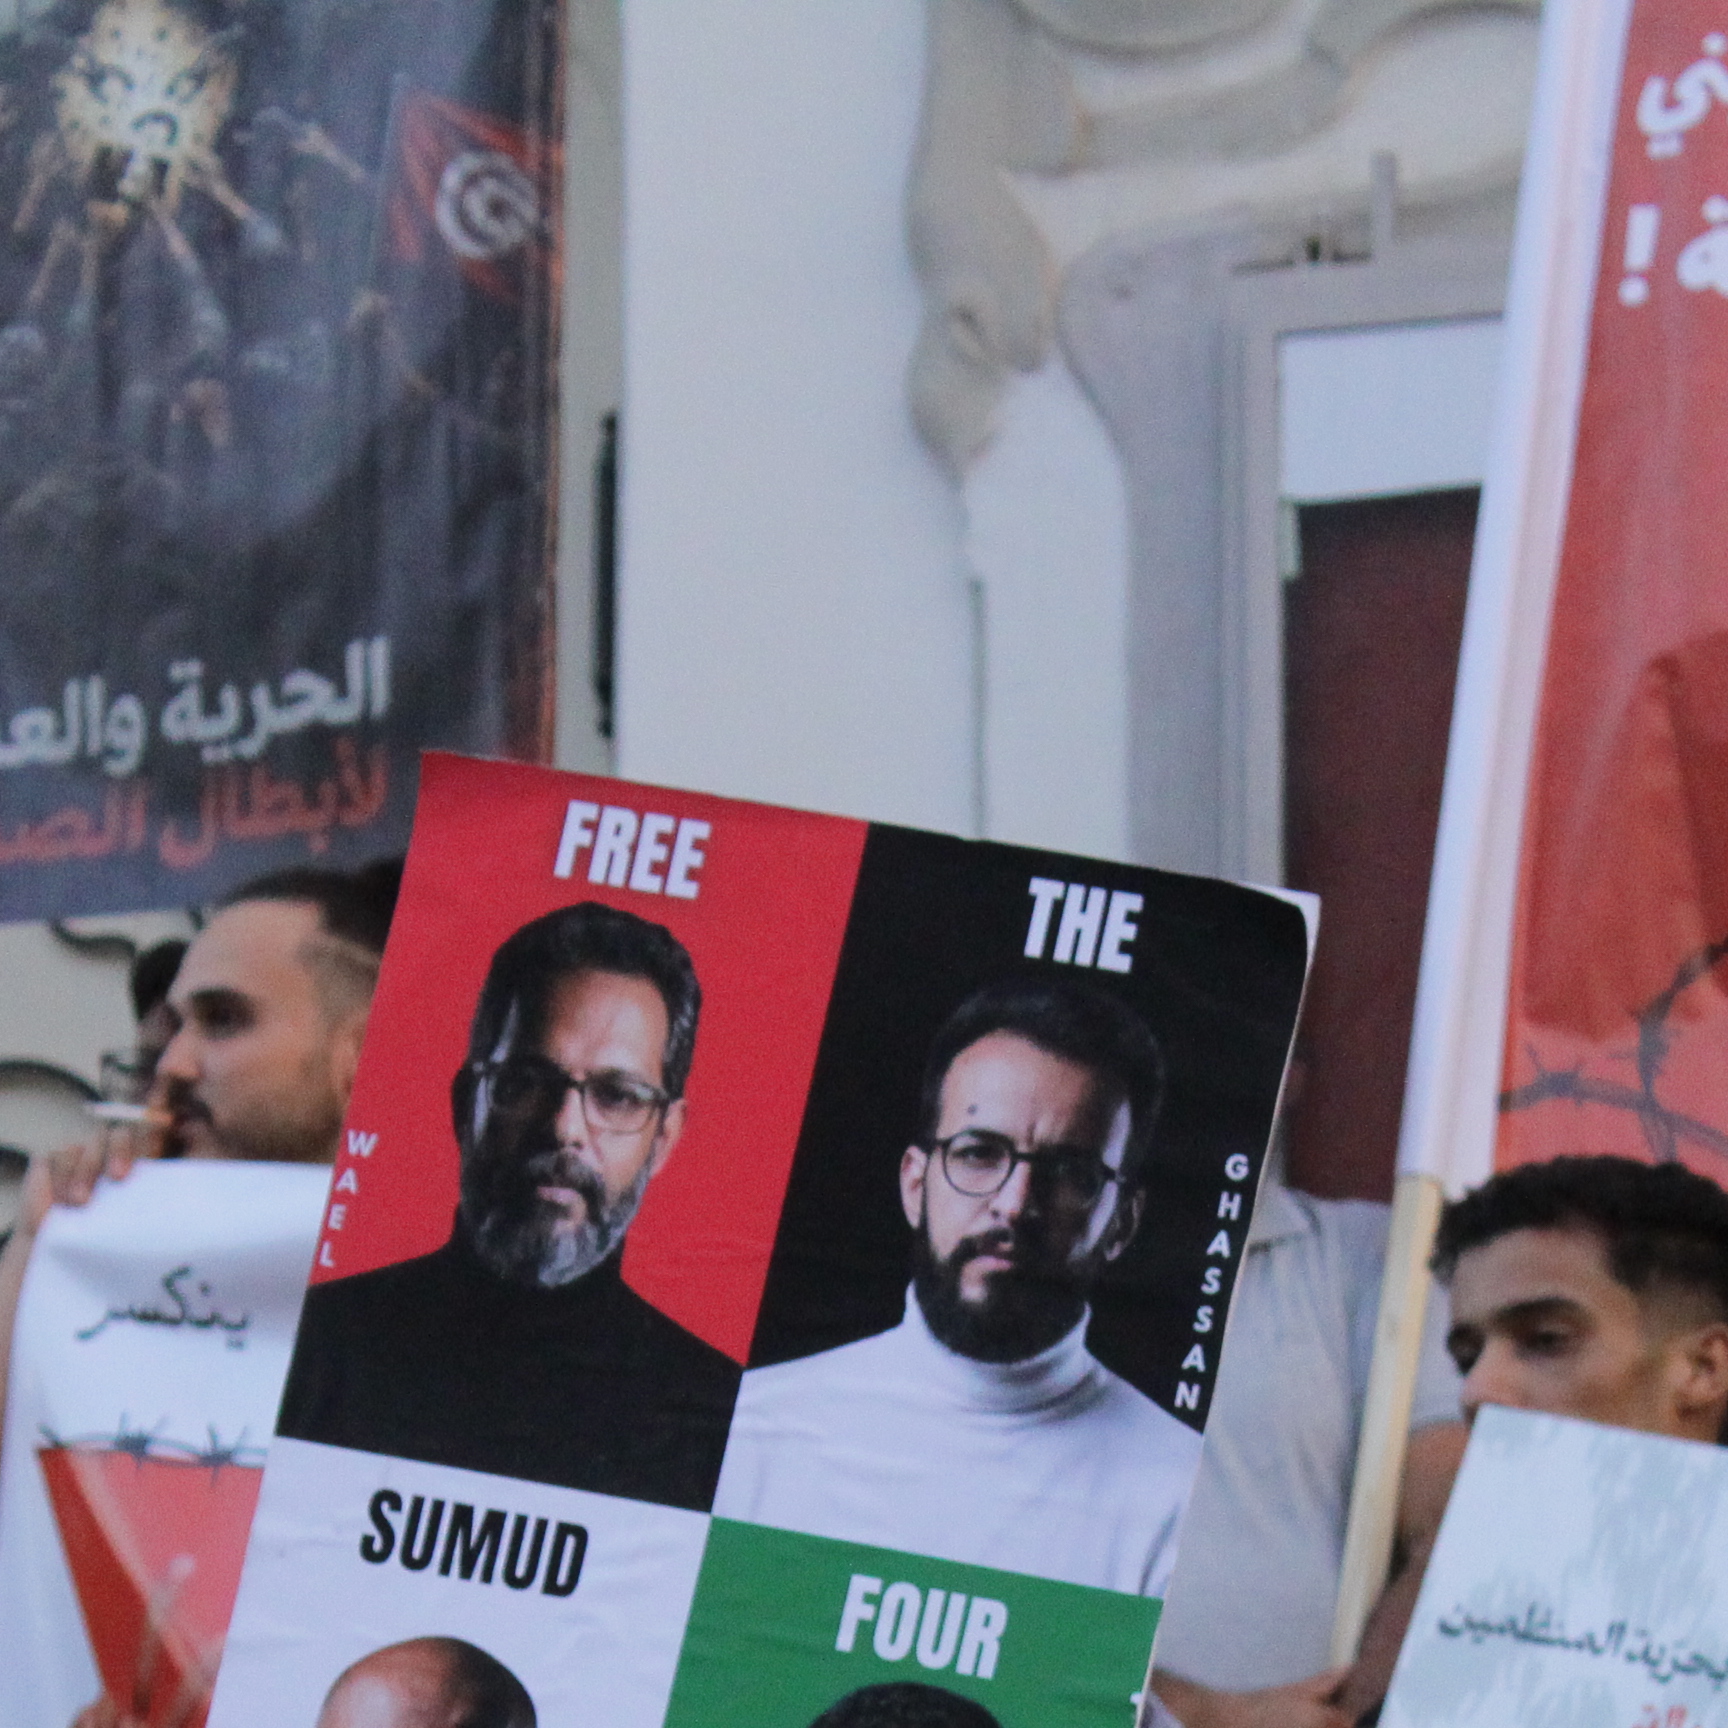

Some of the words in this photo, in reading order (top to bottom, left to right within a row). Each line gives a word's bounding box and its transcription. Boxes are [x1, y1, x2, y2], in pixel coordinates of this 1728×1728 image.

[161, 635, 392, 764] الحرية
[159, 737, 391, 868] لأبطال
[553, 799, 712, 900] FREE
[1024, 876, 1144, 974] THE
[318, 1128, 379, 1269] WAEL
[75, 1264, 249, 1350] ينكسر
[1173, 1153, 1250, 1411] GHASSAN
[359, 1488, 589, 1599] SUMUD
[834, 1572, 1009, 1680] FOUR
